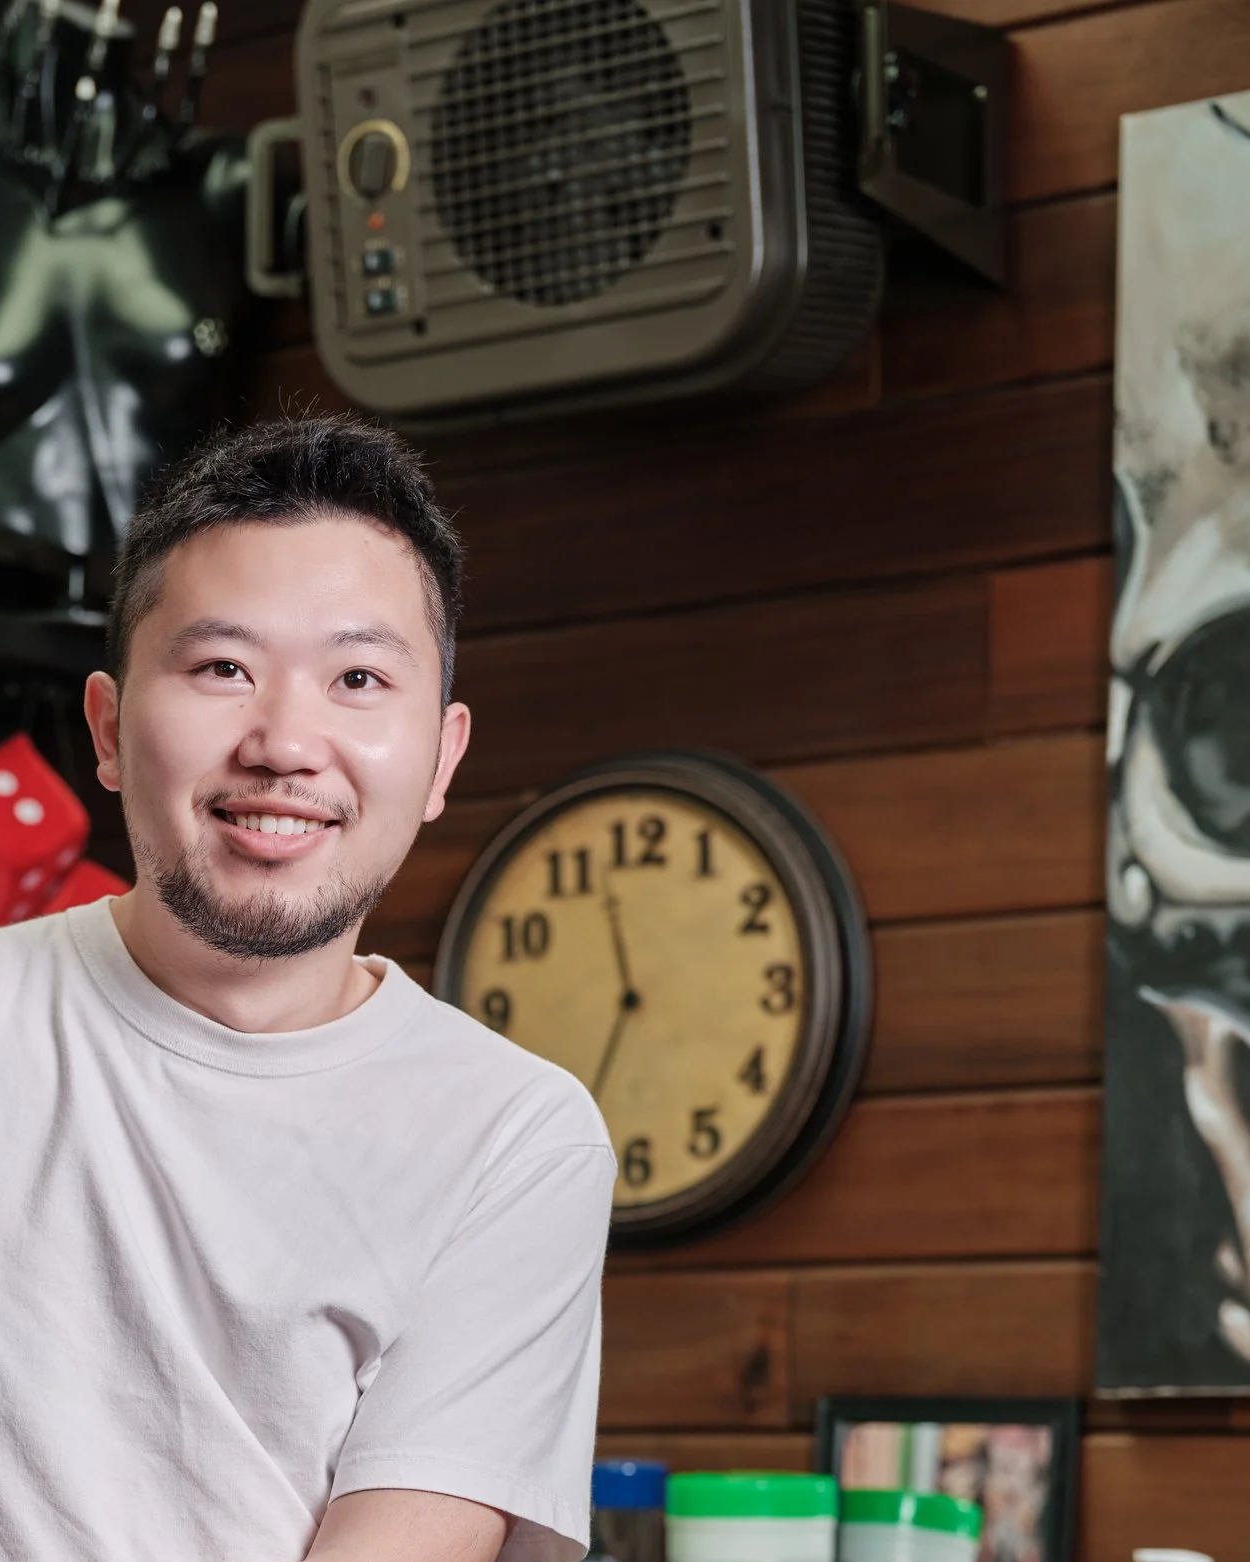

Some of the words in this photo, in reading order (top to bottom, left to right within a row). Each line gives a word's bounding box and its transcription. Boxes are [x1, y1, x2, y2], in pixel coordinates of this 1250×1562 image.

[607, 816, 667, 869] 12
[693, 830, 718, 877] 1
[546, 849, 593, 898] 11
[739, 885, 772, 935] 2
[501, 913, 550, 961] 10
[482, 988, 512, 1031] 9
[762, 966, 797, 1015] 3
[739, 1047, 768, 1094] 4
[688, 1110, 722, 1158] 5
[624, 1138, 653, 1186] 6
